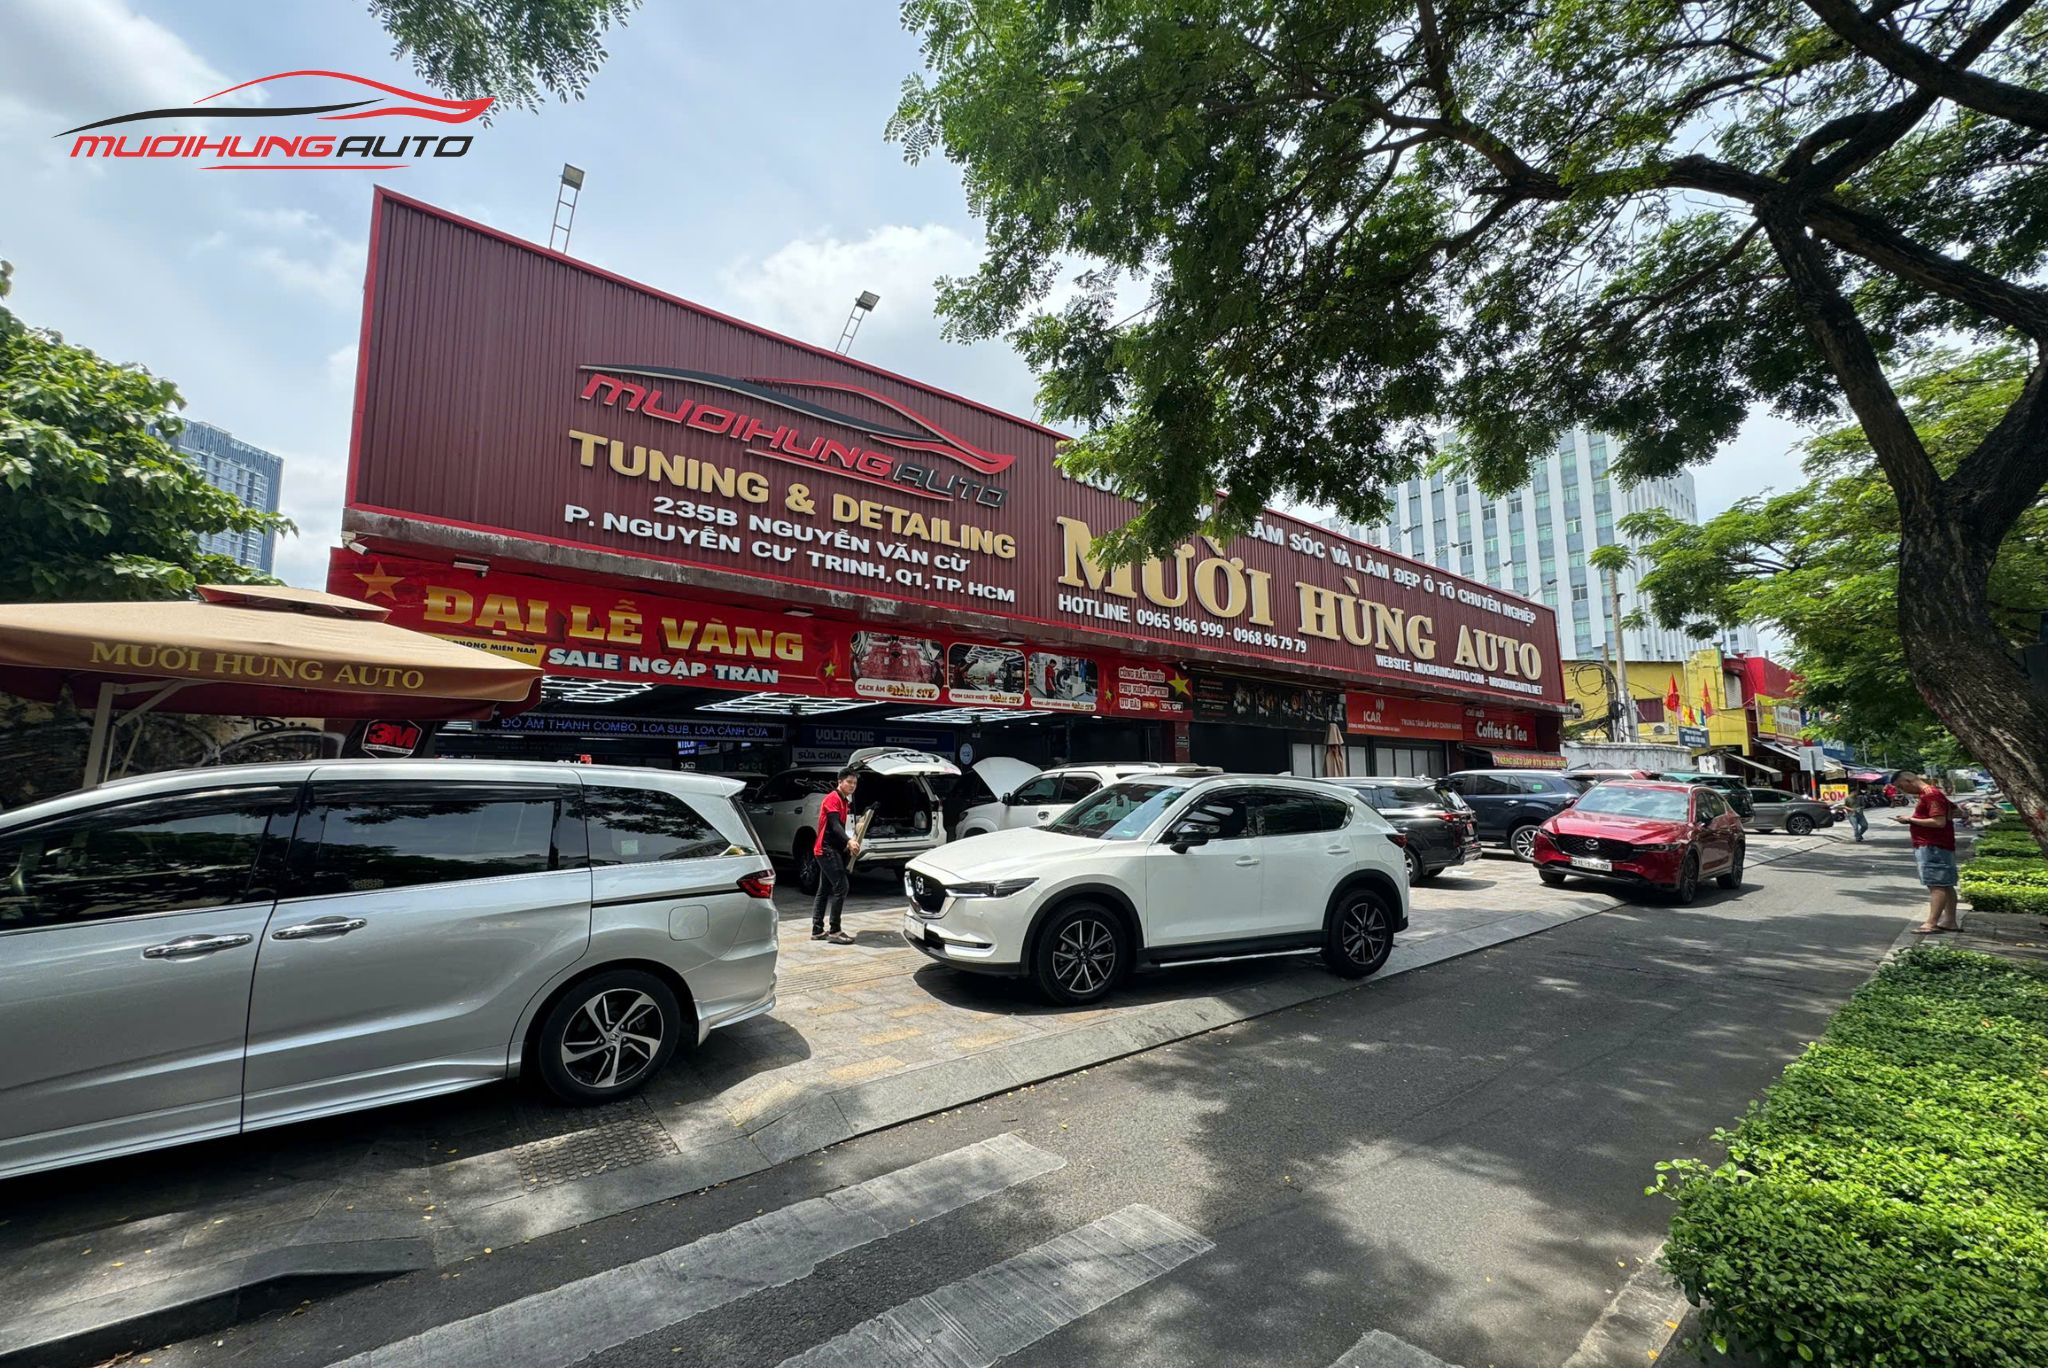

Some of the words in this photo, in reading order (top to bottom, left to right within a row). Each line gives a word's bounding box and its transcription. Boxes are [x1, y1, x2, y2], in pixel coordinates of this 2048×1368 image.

[569, 430, 769, 503] TUNING
[785, 484, 816, 515] &
[833, 493, 1016, 559] DETAILING
[564, 504, 595, 527] P.
[603, 512, 741, 553] NGUYỄN
[751, 541, 797, 562] CƯ
[806, 550, 892, 583] TRINH,
[895, 569, 931, 591] Q1,
[932, 575, 965, 594] TP.
[968, 582, 1015, 603] HCM
[653, 496, 739, 527] 235B
[749, 515, 870, 554] NGUYỄN
[876, 541, 929, 567] VĂN
[934, 553, 970, 573] CỪ
[1056, 516, 1275, 626] MƯỜI
[1295, 576, 1437, 660] HÙNG
[1454, 624, 1542, 681] AUTO
[1289, 531, 1326, 559] SÓC
[1329, 543, 1353, 569] VÀ
[1355, 553, 1390, 580] LÀM
[1393, 567, 1421, 590] ĐẸP
[1423, 574, 1434, 593] Ô
[1437, 580, 1456, 600] TÔ
[1457, 589, 1502, 614] CHUYÊN
[1502, 603, 1537, 628] NGHIỆP
[423, 585, 548, 636] ĐẠI
[569, 599, 643, 644] LỄ
[661, 618, 804, 662] VÀNG
[1137, 608, 1171, 629] 0965
[1173, 615, 1198, 635] 966
[1200, 621, 1224, 639] 999
[1233, 627, 1262, 646] 0968
[516, 646, 537, 654] NAM
[548, 648, 620, 670] SALE
[629, 656, 707, 680] NGẬP
[714, 664, 779, 684] TRÀN
[213, 651, 324, 681] HÙNG
[333, 664, 425, 690] AUTO
[368, 723, 418, 749] 3M
[547, 719, 590, 730] THANH
[642, 724, 665, 733] LOA
[695, 725, 715, 735] LOA
[1363, 711, 1381, 723] ICAR
[1477, 720, 1503, 739] Coffee
[1505, 724, 1511, 740] &
[1513, 725, 1527, 741] Tea
